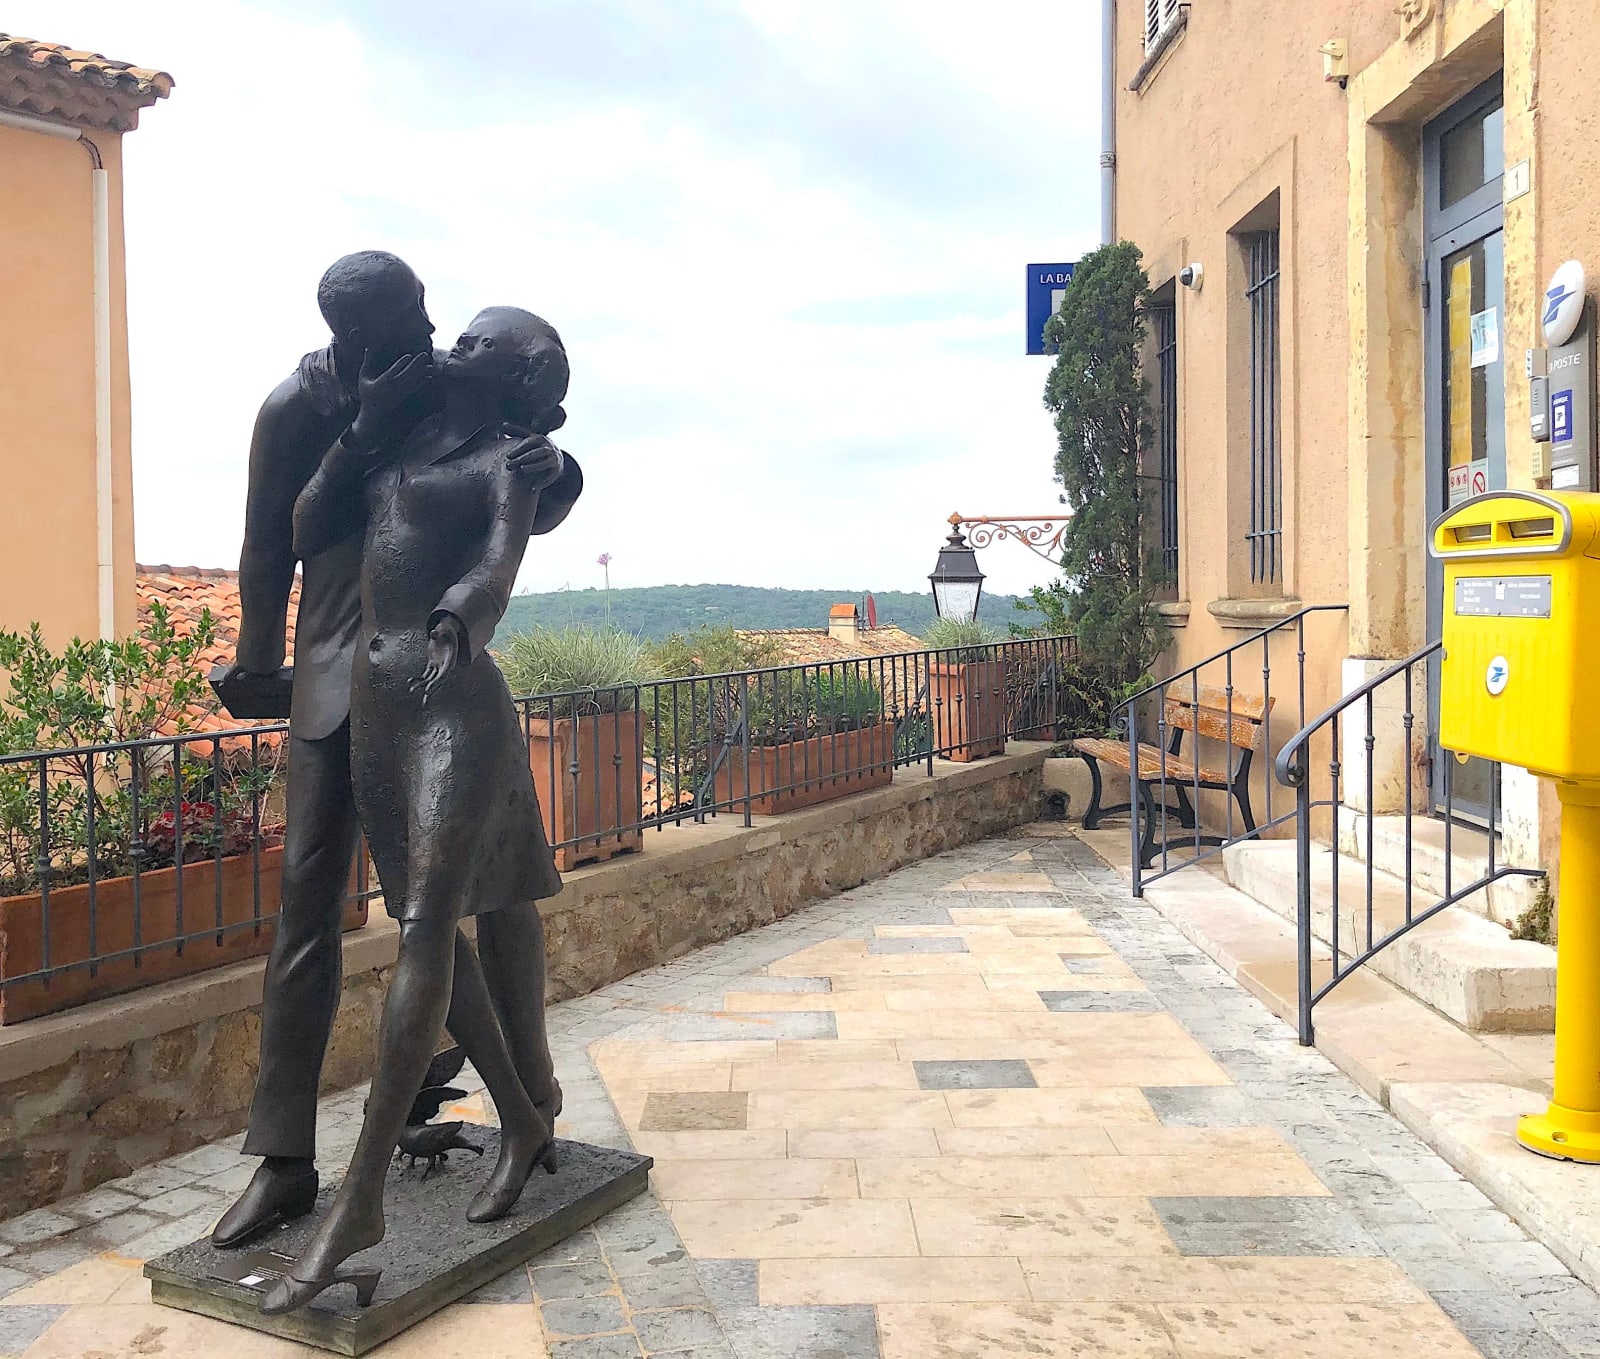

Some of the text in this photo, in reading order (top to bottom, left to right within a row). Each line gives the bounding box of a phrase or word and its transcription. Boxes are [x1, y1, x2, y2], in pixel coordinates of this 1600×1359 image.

[1040, 273, 1072, 284] LA BA
[1553, 352, 1581, 371] POSTE
